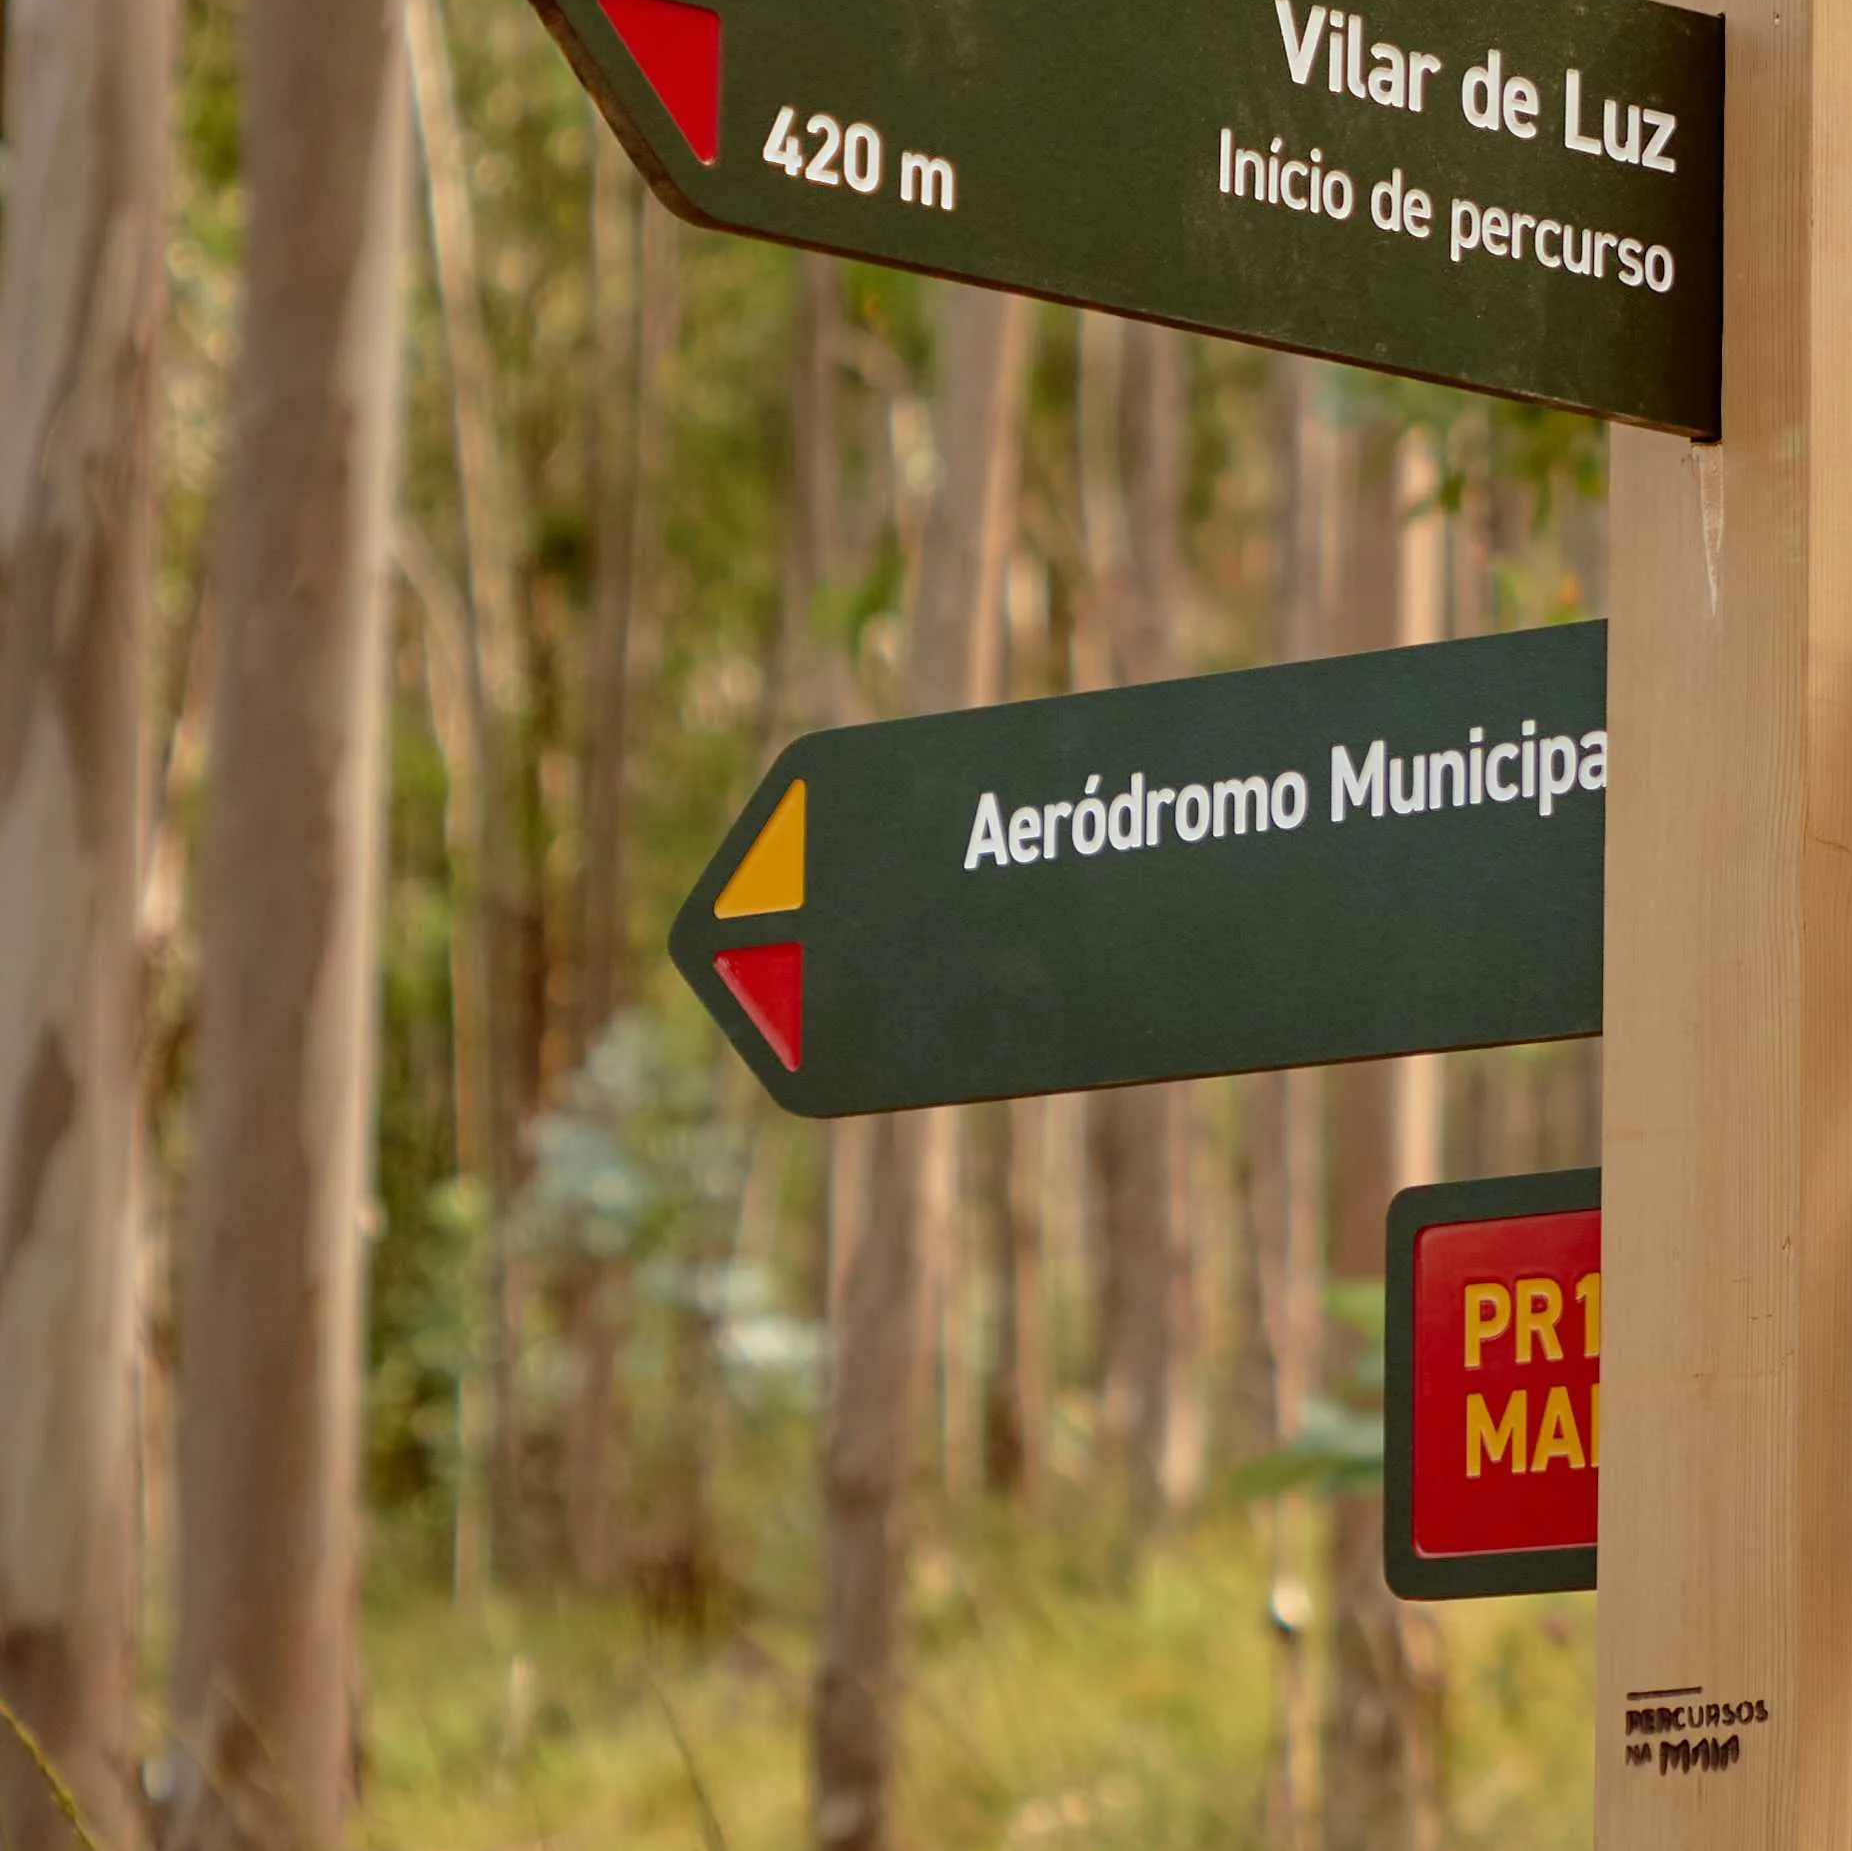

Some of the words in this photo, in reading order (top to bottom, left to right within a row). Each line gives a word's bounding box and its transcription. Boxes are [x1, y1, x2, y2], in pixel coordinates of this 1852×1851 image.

[762, 106, 881, 194] 420
[900, 152, 955, 211] m
[1461, 48, 1540, 139] de
[1564, 68, 1676, 174] Luz
[1218, 128, 1354, 220] Início
[1370, 168, 1433, 238] de
[1450, 198, 1675, 293] percurso
[963, 771, 1309, 871] Aeródromo
[1330, 719, 1607, 823] Municipa
[1464, 1272, 1600, 1369] PR1
[1625, 1699, 1769, 1737] PERCURSOS
